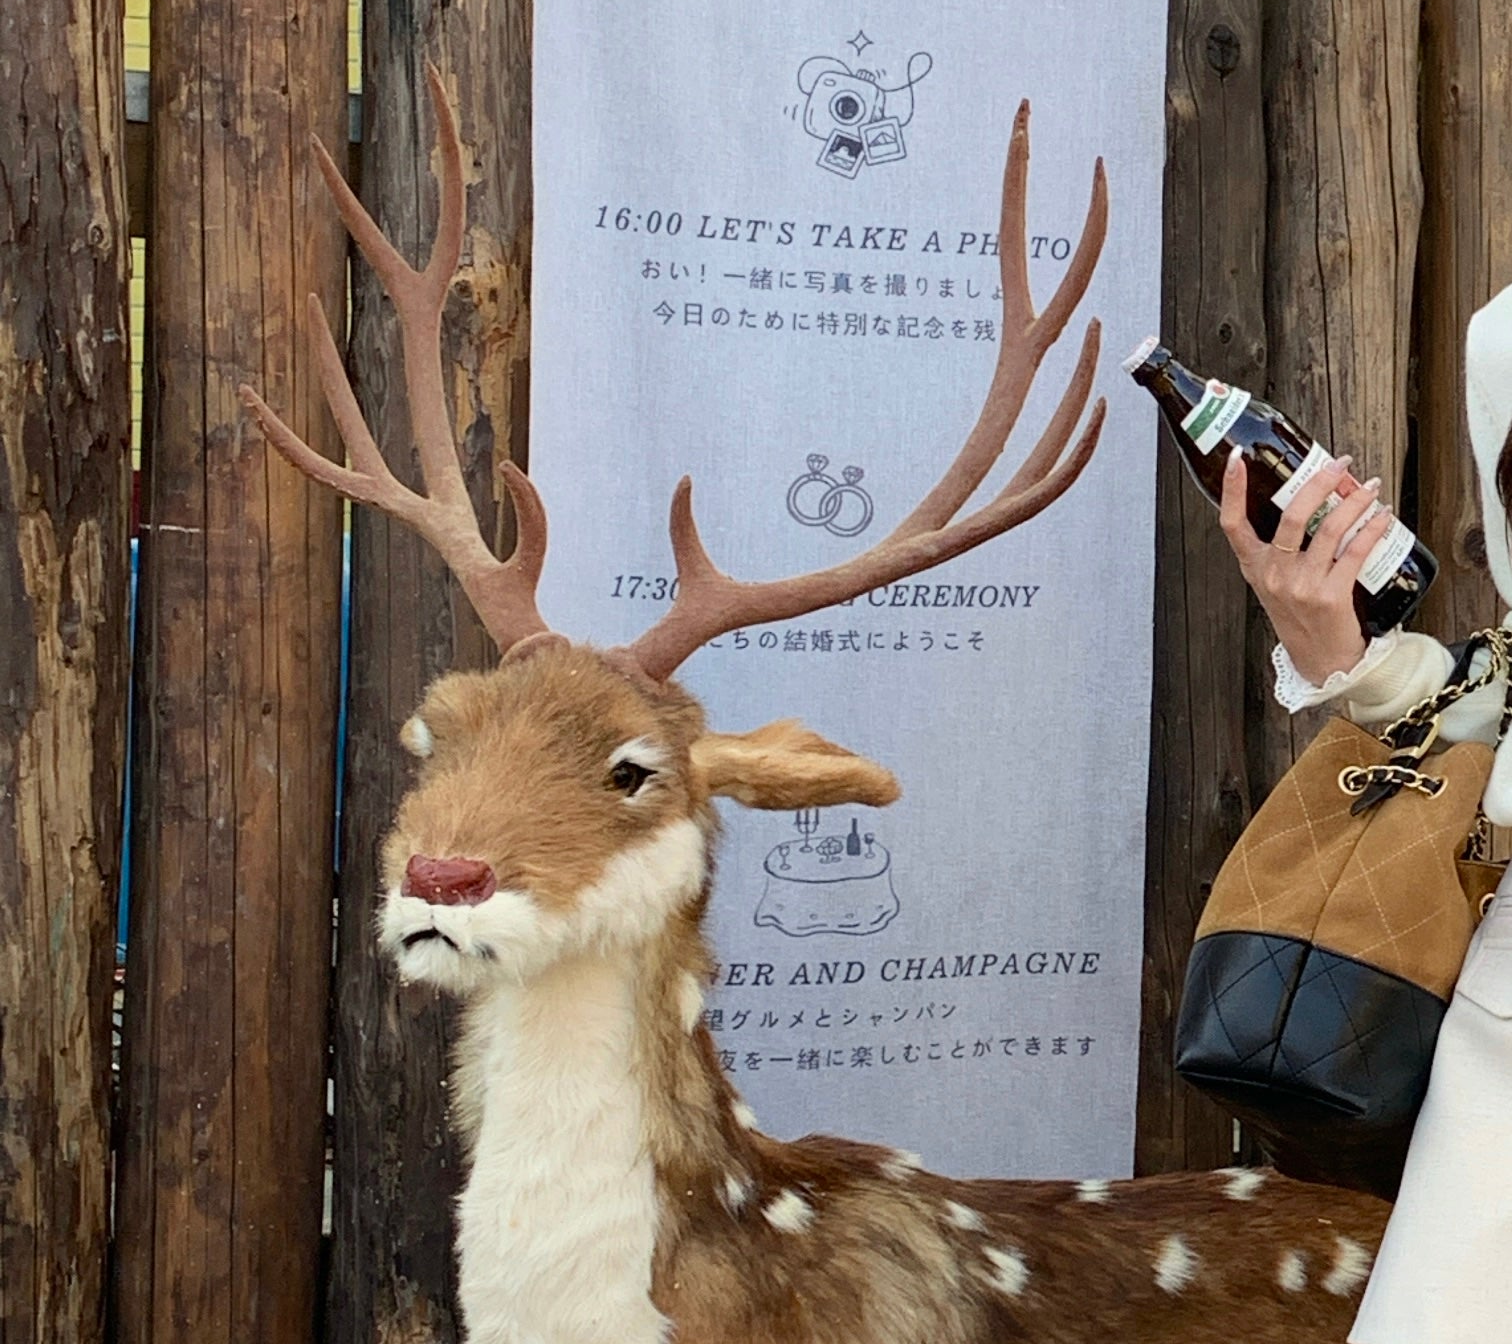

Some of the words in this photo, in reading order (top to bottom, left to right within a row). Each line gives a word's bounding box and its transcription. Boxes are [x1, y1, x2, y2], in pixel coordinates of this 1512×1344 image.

[595, 205, 683, 237] 16:00
[697, 214, 795, 246] LET'S
[811, 223, 908, 253] TAKE
[921, 230, 943, 254] A
[956, 231, 1072, 261] PHTO
[867, 584, 1041, 608] CEREMONY
[789, 960, 866, 986] AND
[880, 951, 1101, 983] CHAMPAGNE
